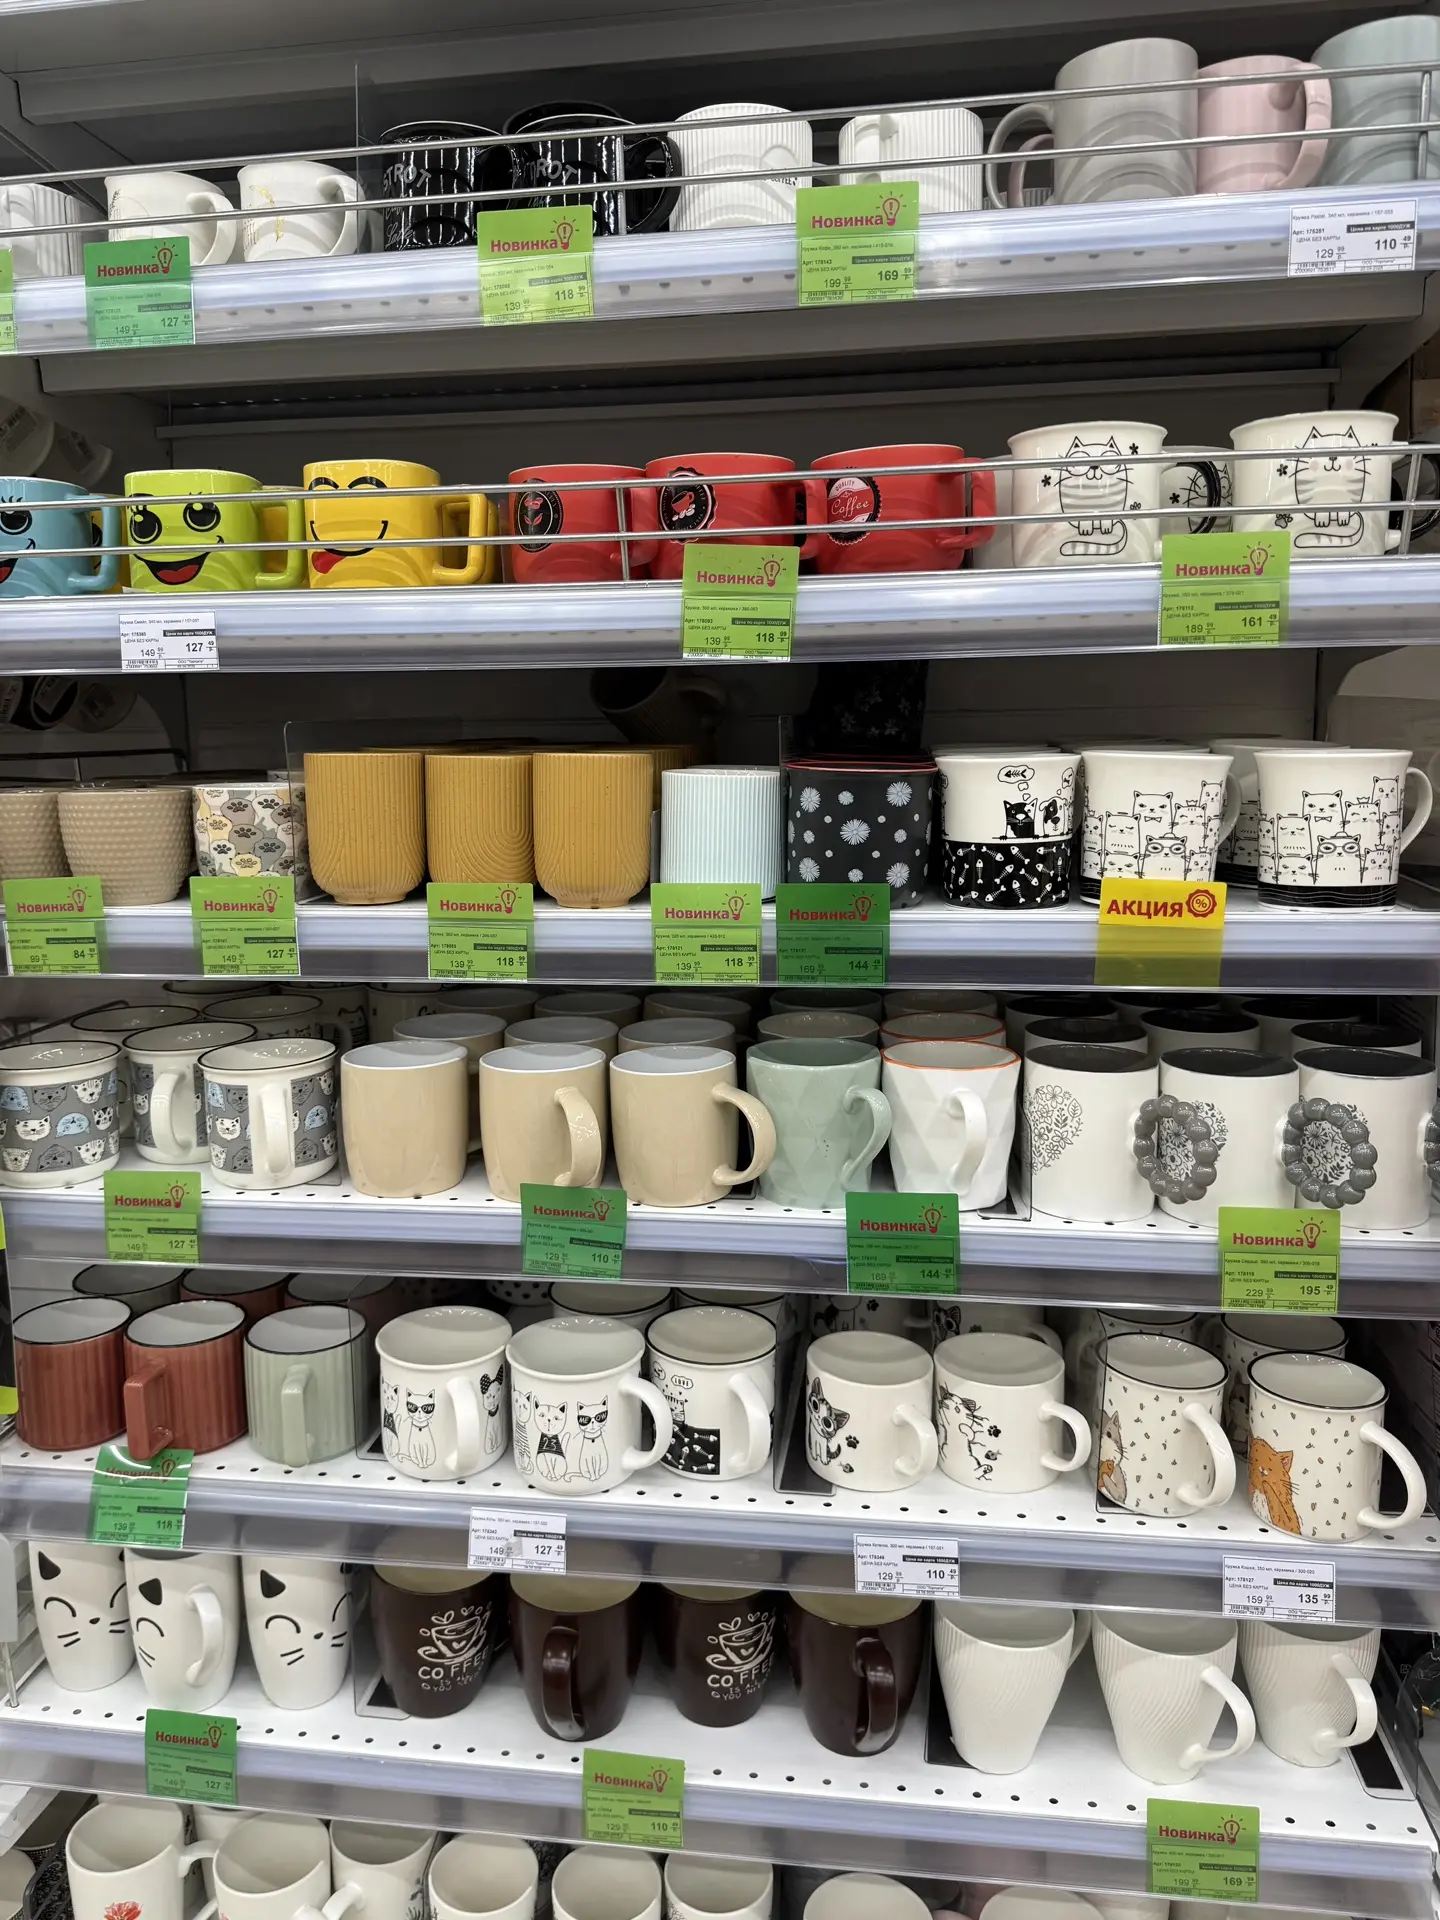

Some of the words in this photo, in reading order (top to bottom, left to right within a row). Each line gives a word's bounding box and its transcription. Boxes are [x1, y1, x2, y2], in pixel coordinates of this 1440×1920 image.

[812, 215, 883, 229] Новинка
[491, 239, 558, 252] Новинка
[1375, 239, 1396, 250] 110
[1316, 249, 1333, 258] 129
[97, 264, 159, 277] Новинка
[878, 270, 898, 281] 169
[824, 279, 841, 288] 199
[555, 289, 574, 300] 118
[505, 302, 520, 311] 139
[161, 317, 179, 327] 127
[115, 326, 130, 334] 149
[831, 496, 869, 518] Coffee
[1176, 564, 1250, 576] Новинка
[697, 571, 764, 585] Новинка
[1242, 617, 1262, 627] 161
[1186, 625, 1203, 633] 189
[705, 637, 720, 645] 139
[756, 633, 774, 642] 118
[186, 643, 203, 652] 127
[17, 903, 74, 913] Новинка
[204, 901, 264, 911] Новинка
[440, 900, 502, 912] Новинка
[1107, 899, 1183, 919] АКЦИЯ
[665, 908, 729, 920] Новинка
[790, 909, 857, 921] Новинка
[74, 950, 85, 958] 84
[267, 950, 284, 958] 127
[450, 960, 464, 968] 139
[497, 957, 514, 966] 118
[725, 958, 743, 967] 118
[849, 961, 868, 970] 144
[800, 965, 815, 973] 169
[114, 1195, 171, 1207] Новинка
[534, 1205, 595, 1219] Новинка
[860, 1220, 926, 1232] Новинка
[169, 1240, 185, 1248] 127
[1233, 1233, 1304, 1247] Новинка
[545, 1252, 559, 1260] 129
[592, 1253, 608, 1263] 110
[921, 1270, 940, 1278] 144
[1246, 1289, 1263, 1297] 229
[1300, 1286, 1320, 1295] 195
[543, 1437, 557, 1450] 23
[156, 1520, 172, 1529] 118
[490, 1547, 504, 1555] 149
[535, 1545, 552, 1555] 127
[878, 1572, 893, 1580] 129
[927, 1569, 945, 1579] 110
[1247, 1596, 1262, 1604] 159
[1298, 1594, 1318, 1604] 135
[730, 1686, 740, 1694] IS
[156, 1731, 209, 1746] Новинка
[205, 1780, 221, 1789] 127
[594, 1772, 653, 1790] Новинка
[651, 1822, 668, 1831] 110
[1159, 1825, 1224, 1842] Новинка
[1174, 1878, 1189, 1886] 199
[1224, 1877, 1242, 1886] 169
